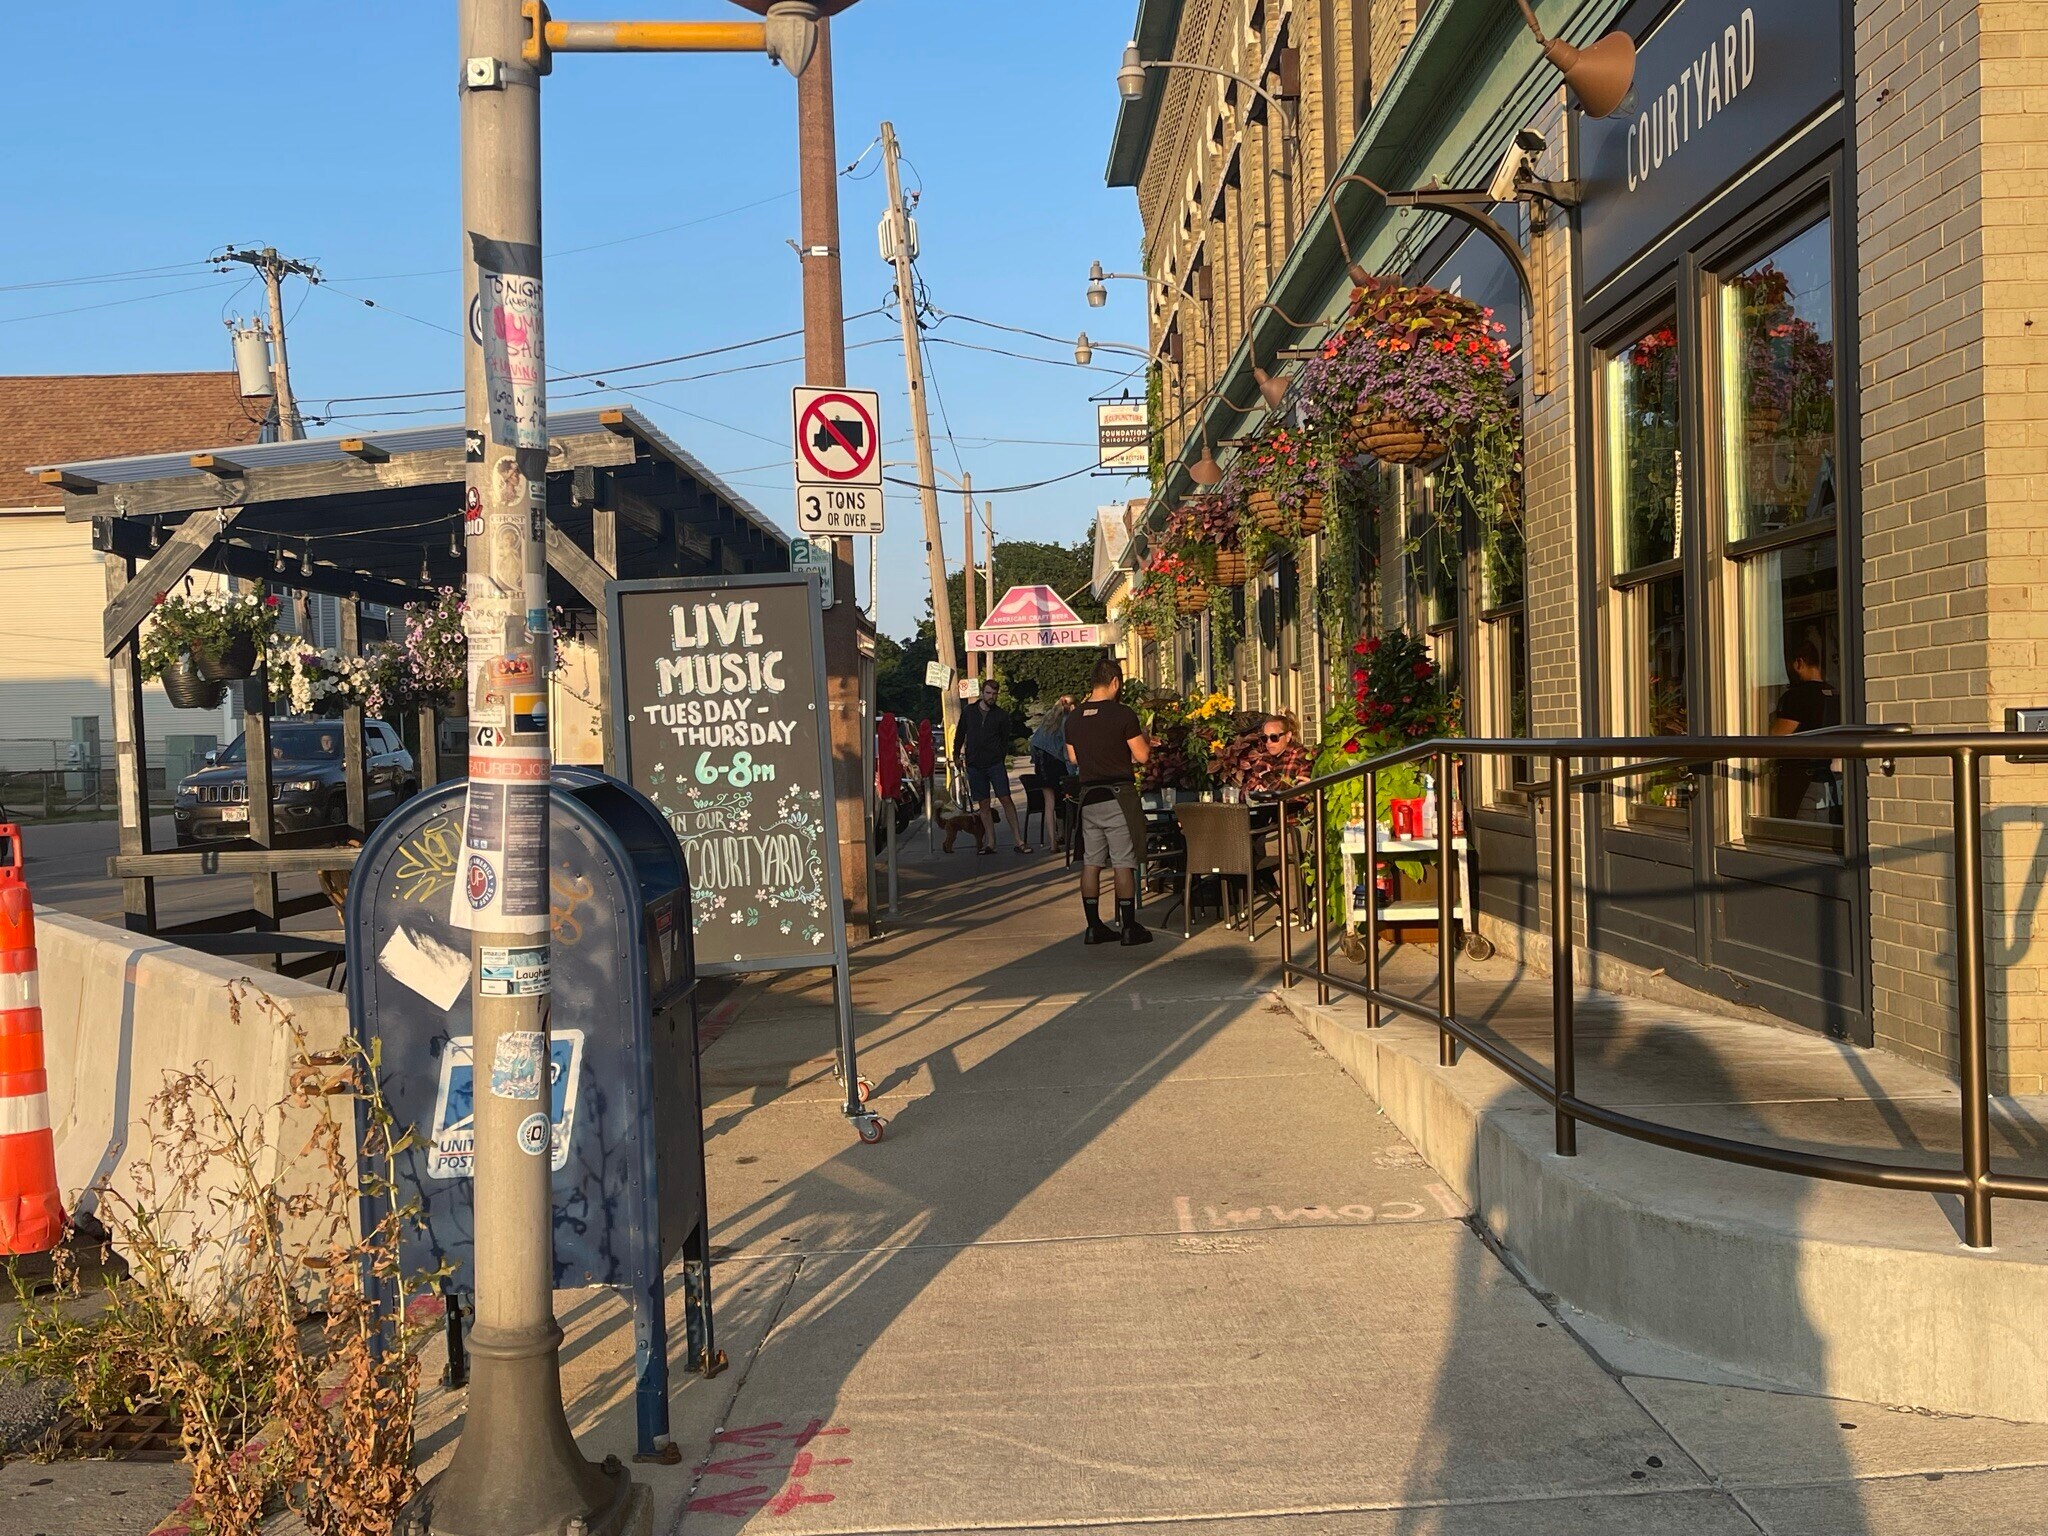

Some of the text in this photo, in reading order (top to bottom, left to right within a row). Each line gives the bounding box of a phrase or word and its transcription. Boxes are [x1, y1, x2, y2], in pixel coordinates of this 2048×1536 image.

[1627, 7, 1755, 193] COURTYARD
[484, 274, 544, 303] TONIGH
[805, 491, 866, 522] 3 TONS
[827, 512, 840, 527] OR
[844, 513, 866, 527] OVER
[794, 545, 808, 563] 2
[669, 600, 764, 650] LIVE
[993, 613, 1069, 624] AMERICAN CRAFT BEER
[975, 630, 1089, 647] SUGAR MAPLE
[655, 651, 786, 698] MUSIC
[643, 698, 752, 726] TUESDAY
[671, 720, 797, 747] THURSDAY
[694, 751, 776, 788] 6-8PM
[671, 811, 727, 832] IN OUR
[684, 833, 804, 890] COURTYARD
[440, 1138, 474, 1153] UNIT
[438, 1155, 474, 1170] POST
